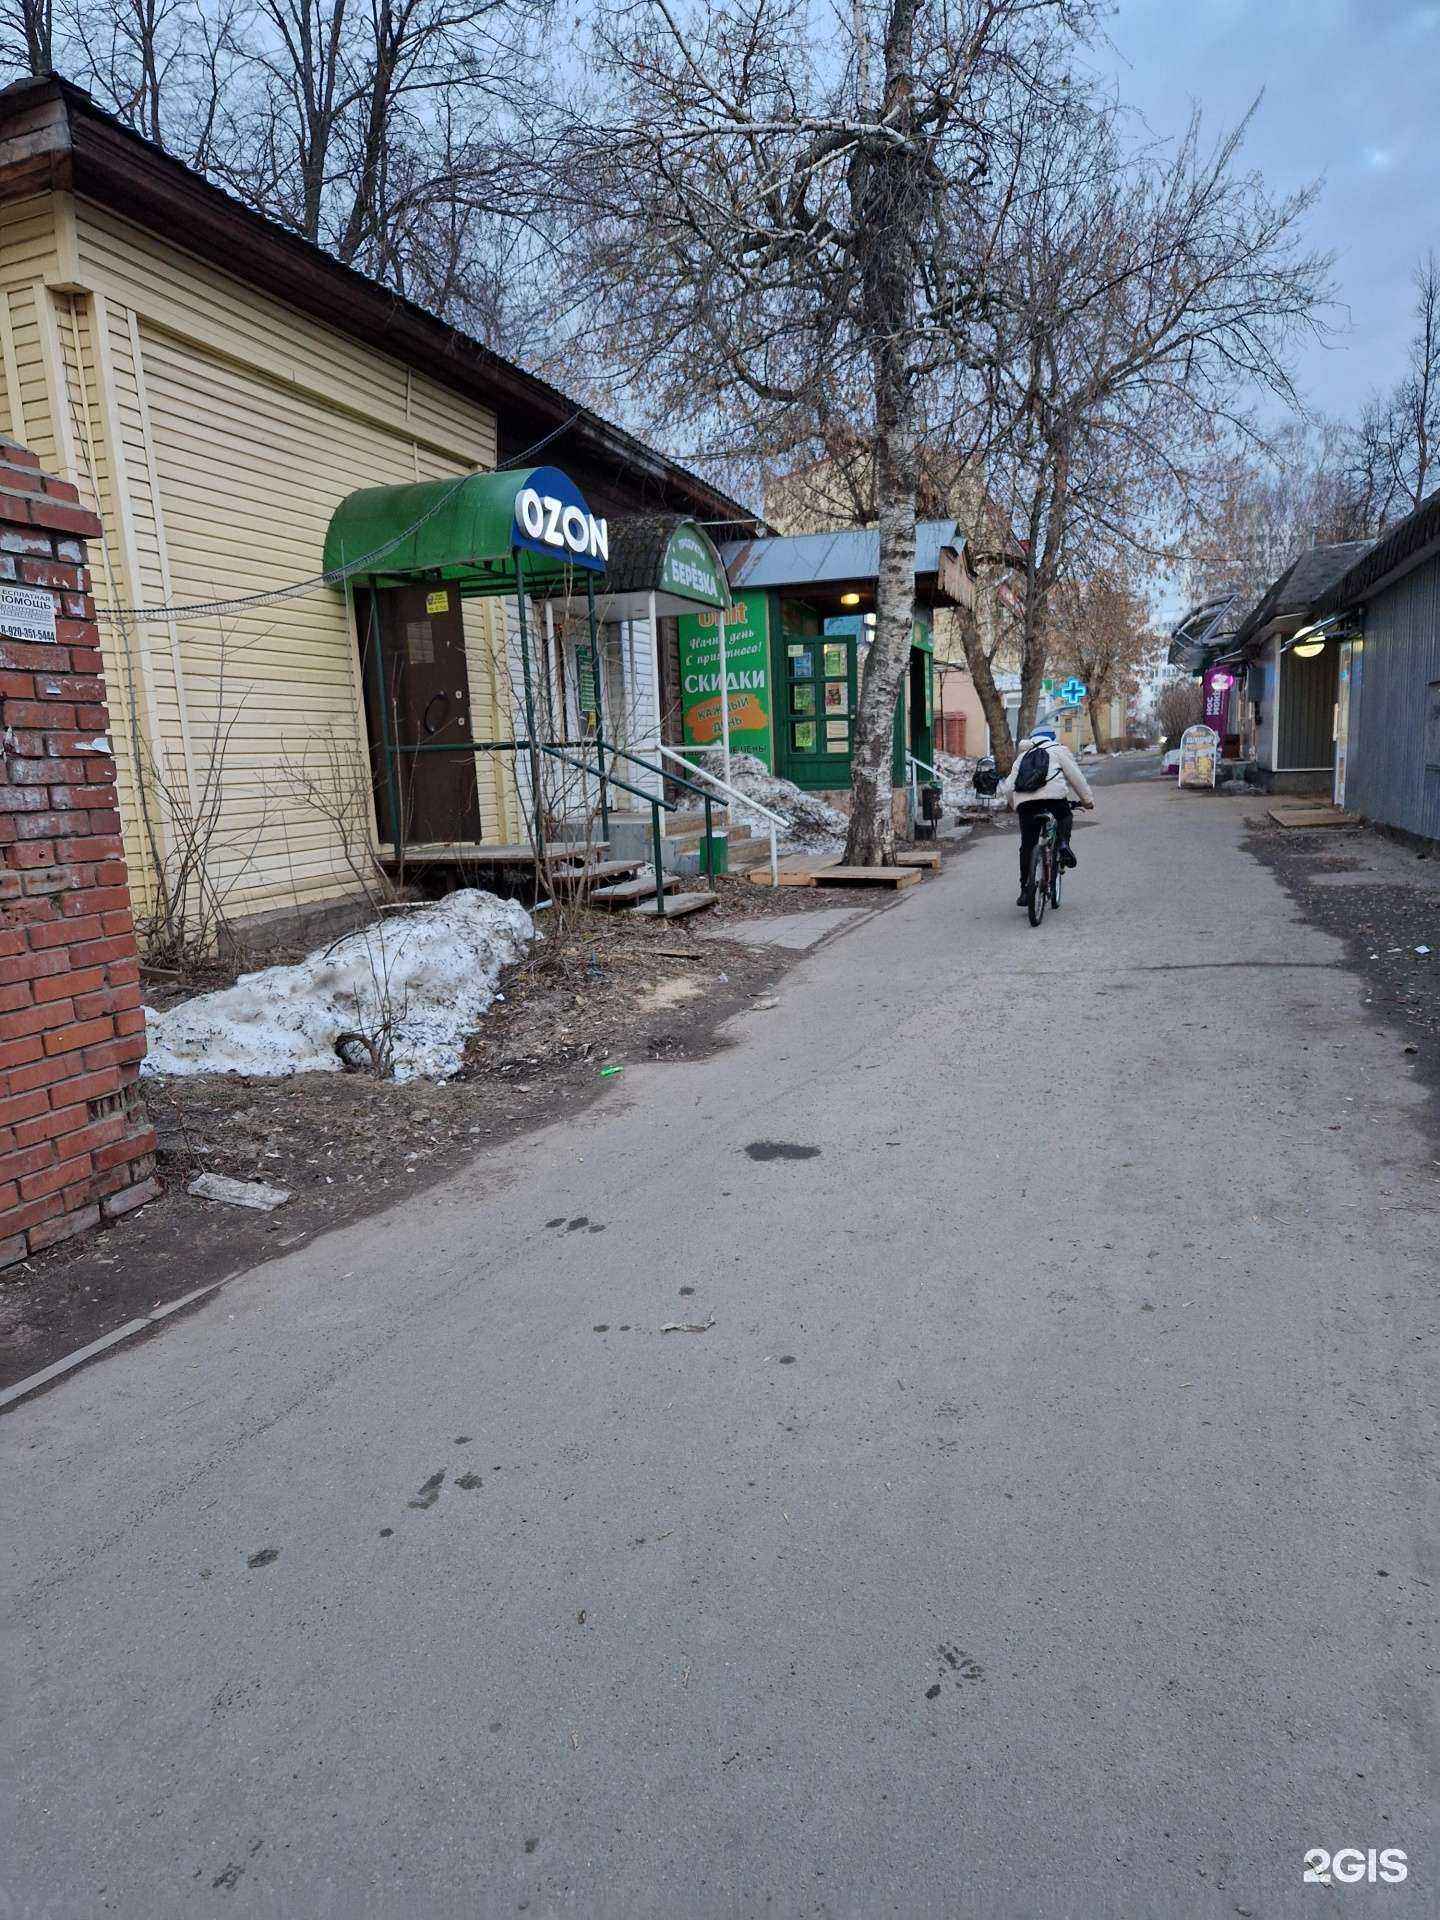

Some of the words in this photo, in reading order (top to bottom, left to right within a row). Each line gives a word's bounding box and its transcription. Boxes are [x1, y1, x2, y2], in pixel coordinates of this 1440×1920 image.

[515, 488, 608, 561] OZON
[0, 589, 51, 602] ЕСПЛАТНАЯ
[729, 630, 753, 645] день
[684, 670, 765, 693] СКИДКИ
[697, 696, 749, 721] КАЖЫЙ
[712, 715, 743, 733] ДНЬ
